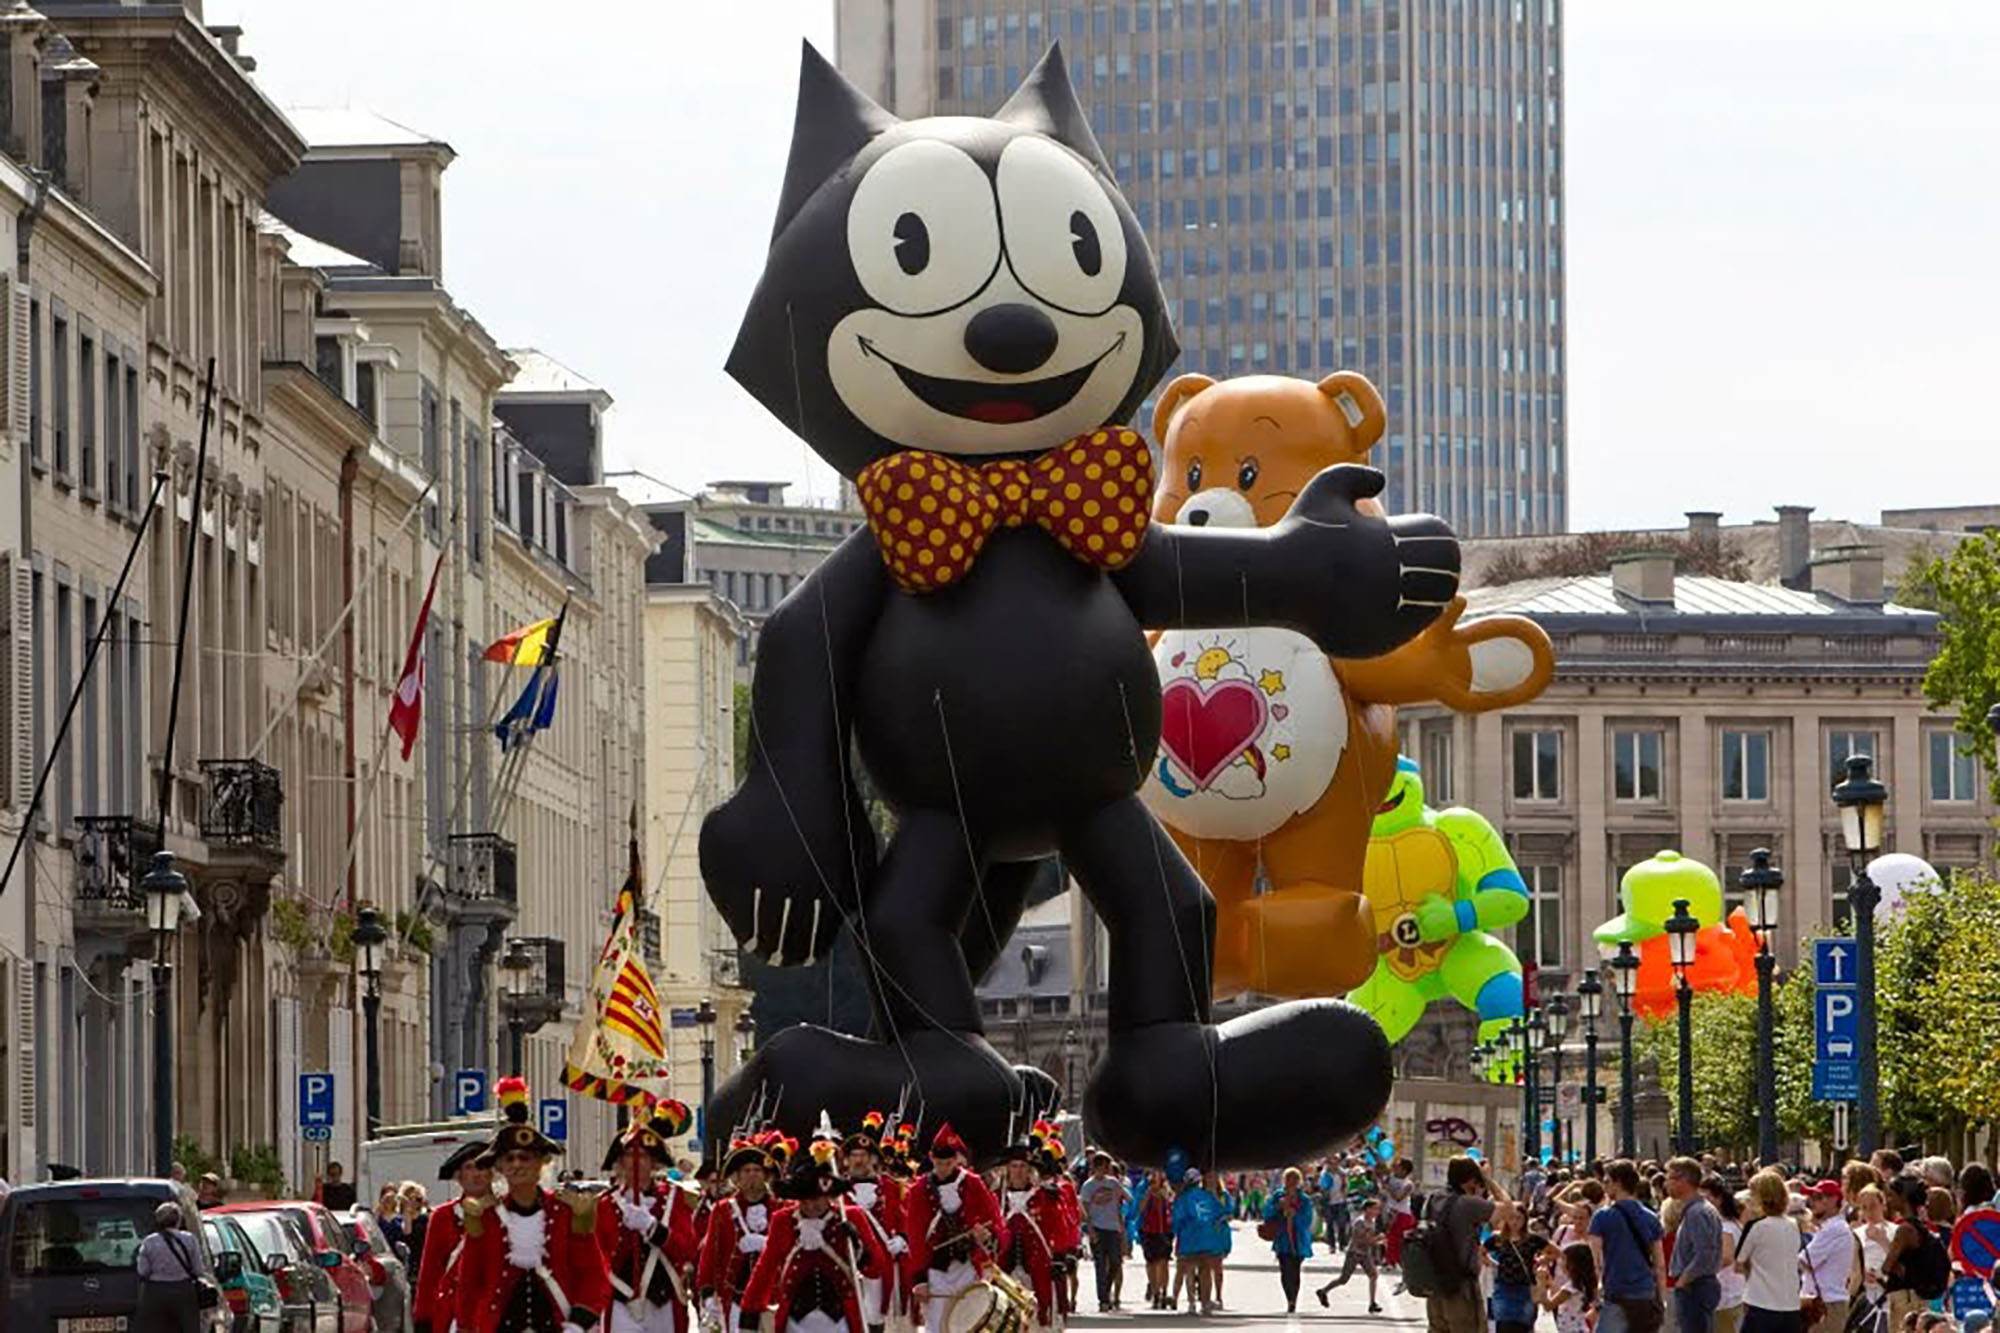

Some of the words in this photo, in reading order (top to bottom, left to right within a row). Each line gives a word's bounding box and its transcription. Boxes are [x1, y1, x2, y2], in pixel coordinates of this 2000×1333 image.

[1827, 995, 1853, 1032] P
[307, 1077, 326, 1105] P
[459, 1079, 480, 1109] P
[543, 1105, 563, 1133] P
